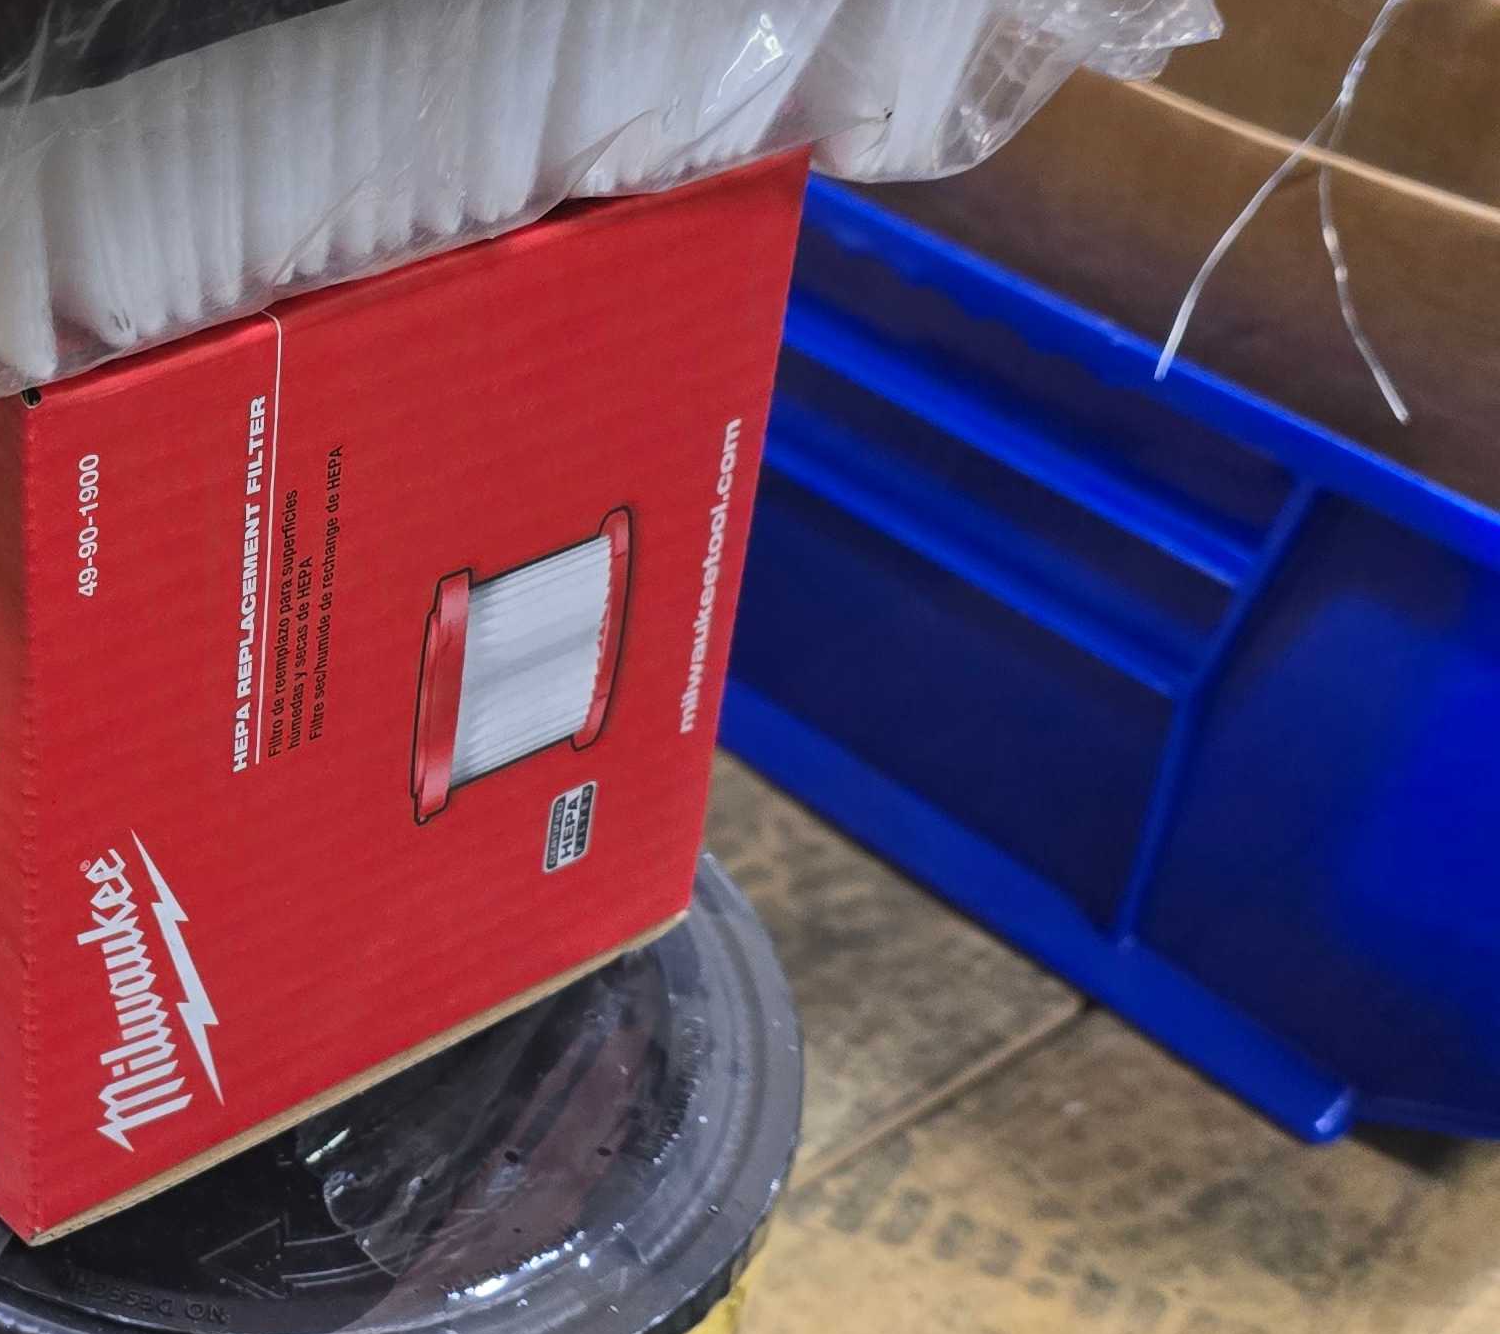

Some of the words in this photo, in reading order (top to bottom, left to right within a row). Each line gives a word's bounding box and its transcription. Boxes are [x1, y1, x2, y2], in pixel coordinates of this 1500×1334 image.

[245, 394, 267, 495] FILTER
[326, 444, 344, 491] HEPA
[78, 453, 100, 597] 49-90-1900
[324, 493, 340, 514] de
[281, 489, 299, 576] superficies
[321, 516, 341, 589] rechange
[236, 503, 261, 698] REPLACEMENT
[278, 578, 294, 614] para
[296, 556, 313, 600] HEPA
[318, 591, 333, 612] de
[679, 417, 743, 735] milwaukeetool.com
[296, 601, 310, 622] de
[274, 617, 291, 695] reemplazo
[294, 624, 308, 668] secas
[313, 614, 331, 700] sec/humide
[295, 671, 308, 681] y
[271, 697, 285, 716] de
[308, 701, 325, 740] Filtre
[232, 701, 251, 774] HEPA
[267, 719, 284, 758] Filtro
[560, 794, 580, 860] HEPA
[77, 847, 194, 1153] Milwaukee
